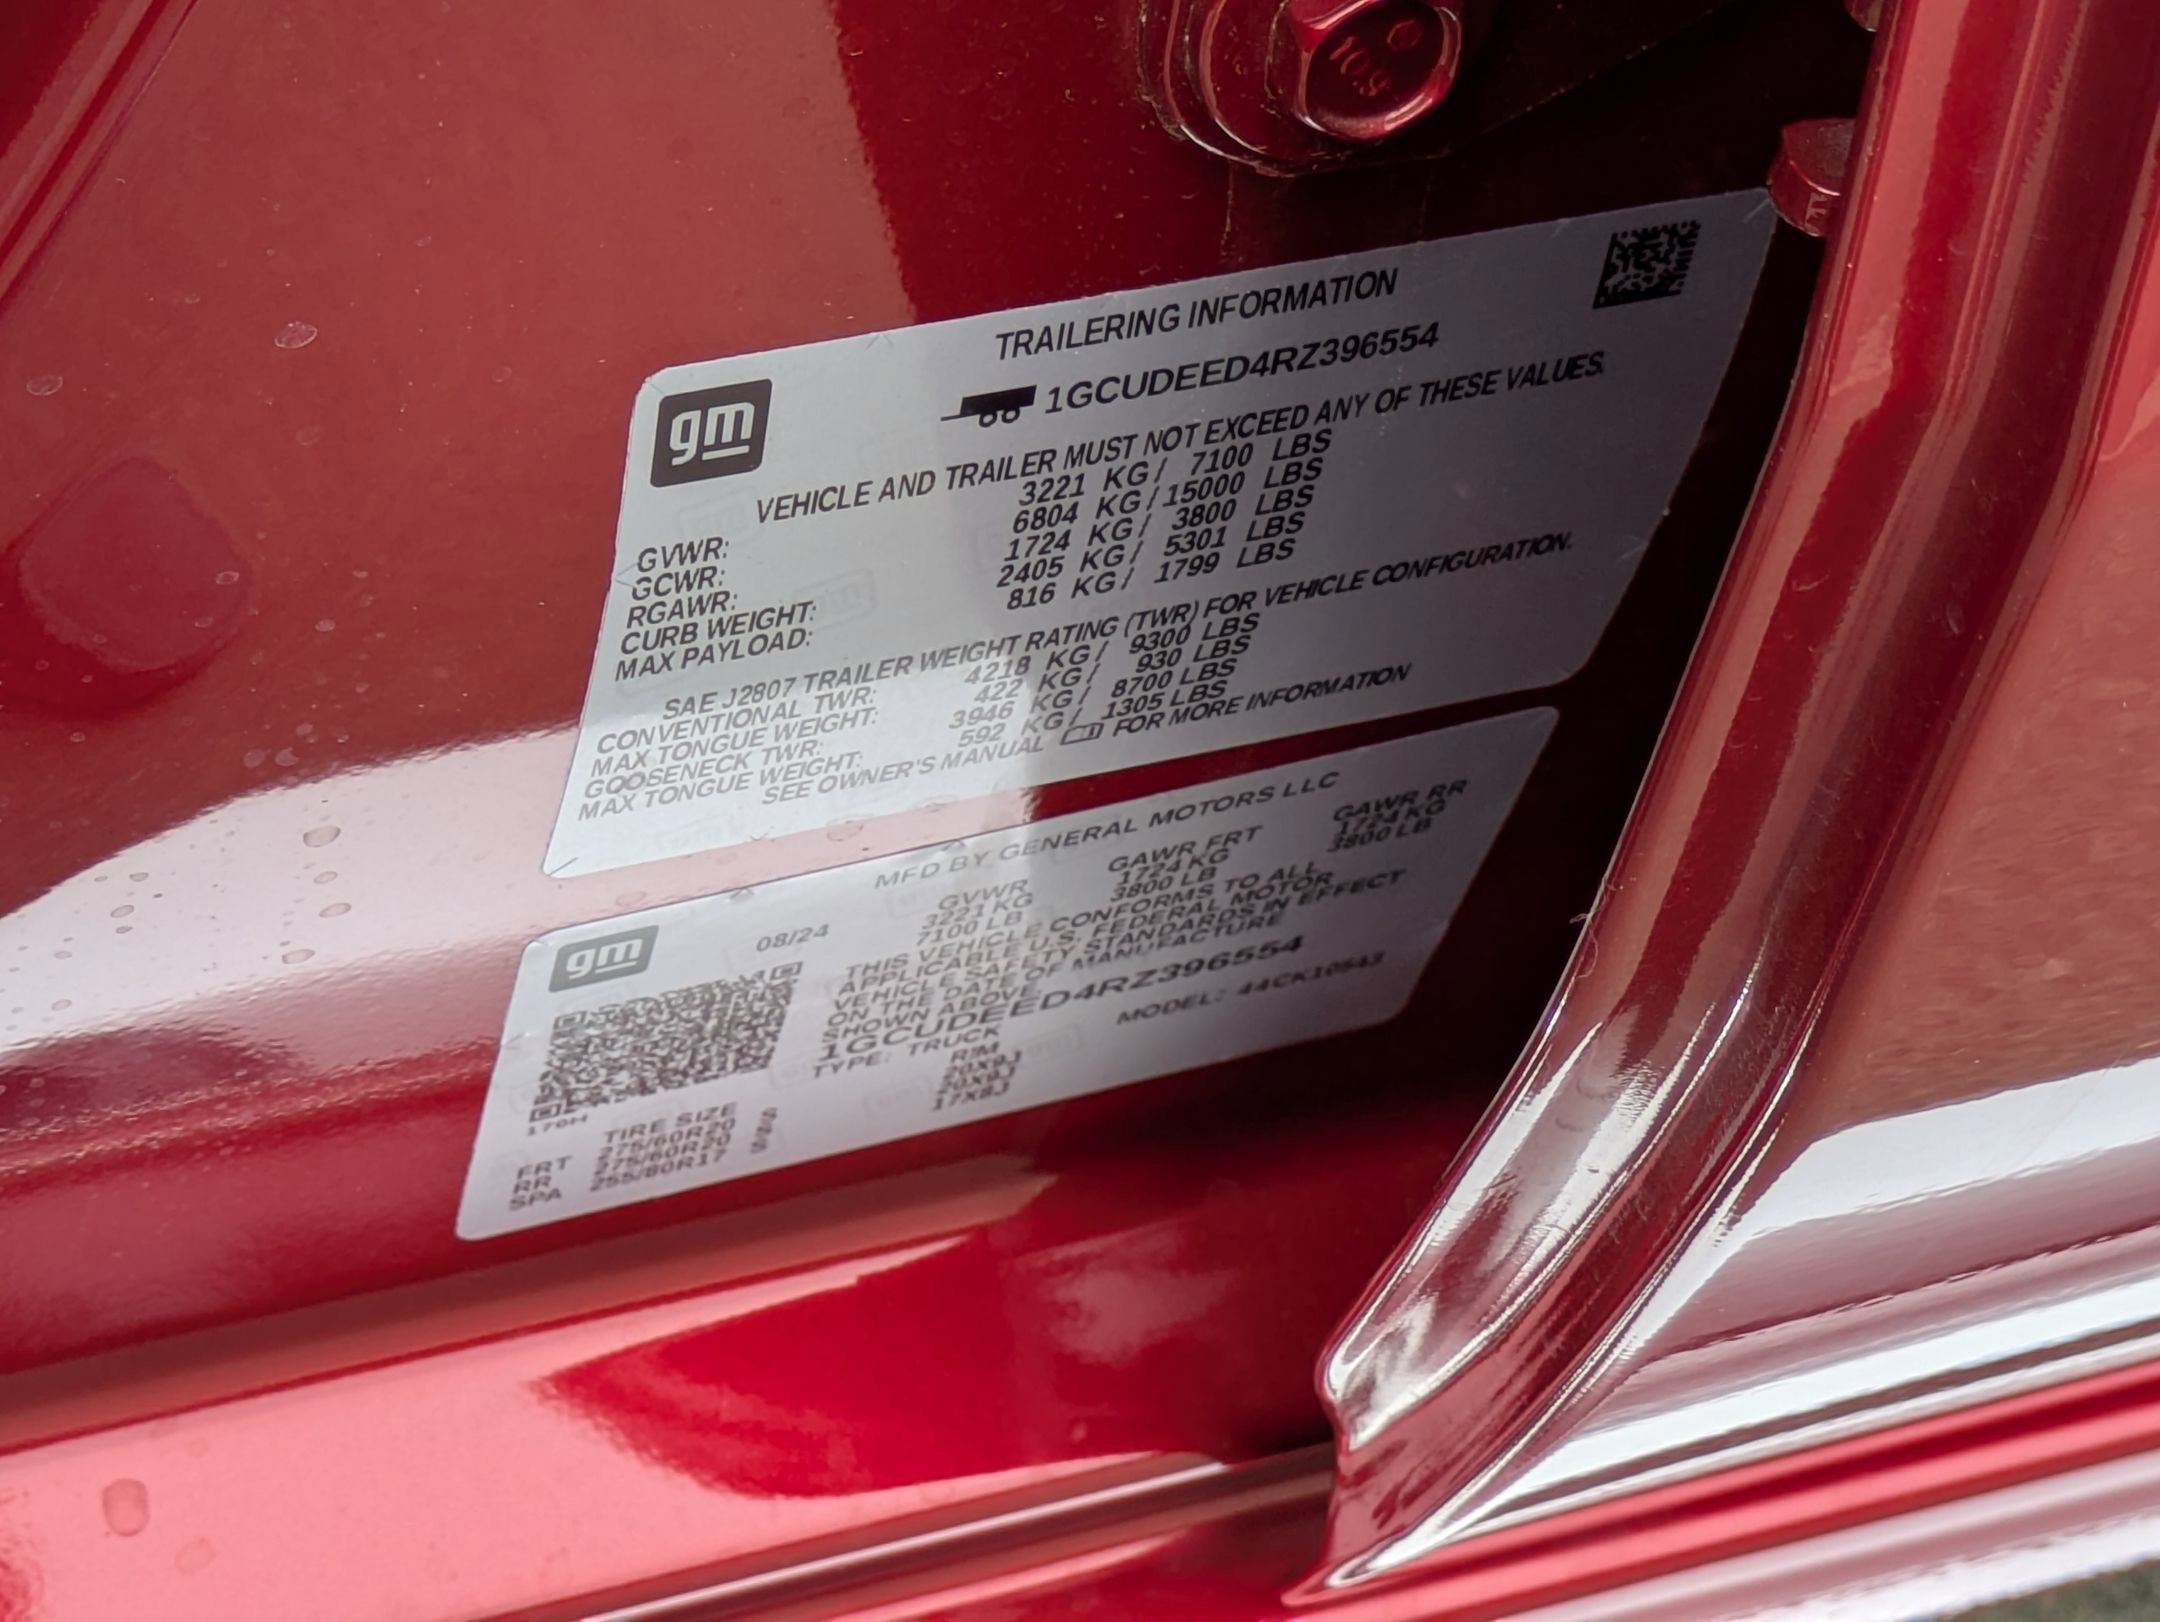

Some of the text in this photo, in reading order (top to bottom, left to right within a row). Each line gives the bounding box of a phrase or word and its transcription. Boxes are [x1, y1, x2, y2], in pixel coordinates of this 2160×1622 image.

[997, 269, 1396, 358] TRAILERING INFORMATION
[1048, 324, 1436, 412] 1GCUDEED4RZ396554
[757, 481, 871, 522] VEHICLE
[878, 470, 935, 501] AND
[947, 449, 1056, 489] TRAILER
[1063, 434, 1137, 468] MUST
[1143, 422, 1200, 455] NOT
[1204, 404, 1308, 444] EXCEED
[1313, 393, 1369, 425] ANY
[1374, 385, 1411, 414] OF
[1419, 369, 1501, 406] THESE
[631, 565, 723, 600] GCWR:
[1012, 501, 1078, 533] 6804
[1163, 471, 1244, 506] 15000
[1263, 456, 1322, 488] LBS
[637, 536, 728, 572] GVWR:
[1019, 473, 1084, 505] 3221
[1191, 442, 1253, 475] 7100
[1272, 428, 1331, 460] LBS
[620, 622, 698, 654] CURB
[707, 601, 815, 638] WEIGHT:
[997, 555, 1064, 587] 2405
[1163, 526, 1226, 556] 5301
[1246, 510, 1305, 541] LBS
[627, 590, 736, 627] RGAWR:
[1004, 529, 1070, 561] 1724
[1172, 498, 1236, 530] 3800
[1254, 484, 1314, 515] LBS
[615, 651, 675, 680] MAX
[681, 628, 811, 668] PAYLOAD:
[1006, 582, 1055, 609] 816
[1154, 552, 1219, 582] 1799
[1236, 537, 1295, 568] LBS
[662, 691, 717, 719] SAE
[721, 676, 796, 708] J2807
[804, 655, 913, 692] TRAILER
[920, 634, 1021, 670] WEIGHT
[1025, 616, 1118, 651] RATING
[1124, 601, 1198, 637] (TWR)
[1203, 591, 1256, 617] FOR
[1265, 569, 1368, 605] VEHICLE
[584, 752, 750, 798] GOOSENECK
[762, 739, 823, 765] TWR:
[948, 700, 1014, 729] 3946
[1111, 670, 1172, 697] 8700
[1179, 657, 1236, 685] LBS
[590, 749, 650, 777] MAX
[658, 727, 767, 763] TONGUE
[774, 706, 877, 741] WEIGHT:
[973, 676, 1025, 702] 422
[1135, 647, 1182, 673] 930
[1192, 634, 1250, 662] LBS
[597, 700, 800, 753] CONVENTIONAL
[814, 685, 875, 713] TWR:
[964, 655, 1031, 683] 4218
[1129, 624, 1191, 653] 9300
[1201, 612, 1259, 640] LBS
[578, 793, 636, 820] MAX
[645, 771, 753, 807] TONGUE
[759, 751, 862, 785] WEIGHT:
[957, 722, 1006, 747] 592
[1101, 692, 1164, 719] 1305
[1169, 679, 1227, 706] LBS
[761, 665, 1410, 804] SEE OWNER'S MANUAL FOR MORE INFORMATION
[874, 771, 1339, 888] MFD BY GENERAL MOTORS LLC
[1108, 825, 1262, 871] GAWR FRT
[1327, 816, 1432, 852] 3800 LB
[1332, 779, 1467, 821] GAWR RR
[1336, 798, 1445, 837] 1724 KG
[922, 892, 1033, 929] 3221 KG
[938, 877, 1030, 910] GVWR
[1110, 866, 1217, 902] 3800 LB
[1117, 847, 1229, 886] 1724 KG
[756, 923, 828, 951] 08/24
[827, 912, 1281, 1027] ON THE DATE OF MANUFACTURE
[834, 869, 1405, 1011] VEHICLE SAFETY STANDARDS IN EFFECT
[838, 943, 1018, 995] APPLICABLE
[1092, 899, 1217, 938] FEDERAL
[1230, 872, 1332, 905] MOTOR
[847, 860, 1317, 979] THIS VEHICLE CONFORMS TO ALL
[916, 910, 1022, 946] 7100 LB
[822, 937, 1300, 1059] 1GCUDEED4RZ396554
[822, 1007, 930, 1042] SHOWN
[909, 1024, 999, 1055] TRUCK
[1117, 990, 1223, 1024] MODEL:
[516, 1155, 571, 1180] FRT
[605, 1102, 735, 1143] TIRE SIZE
[512, 1175, 551, 1194] RR
